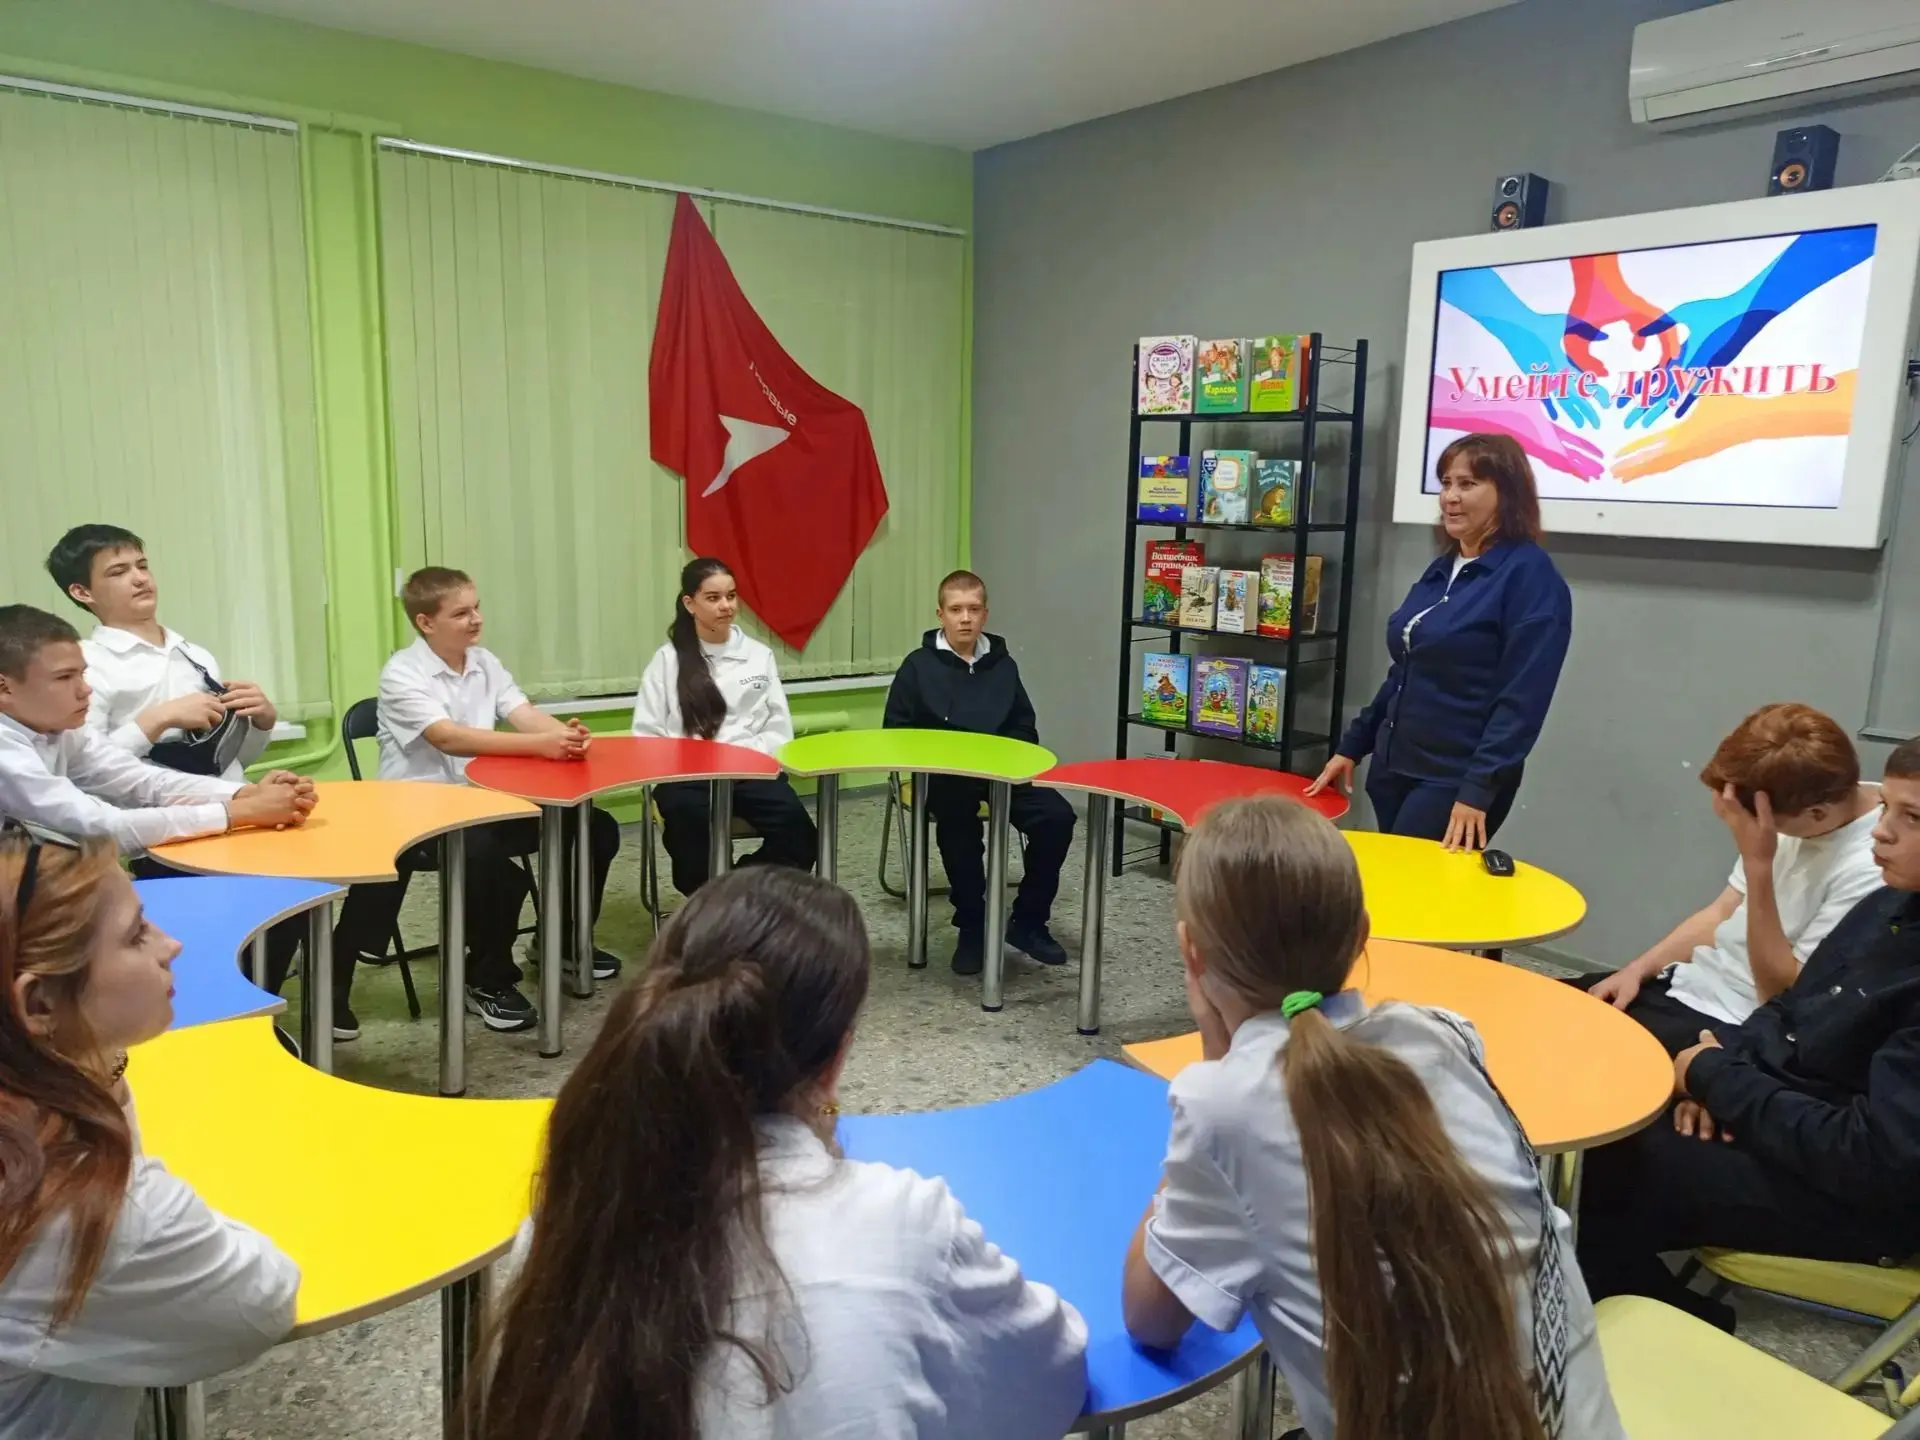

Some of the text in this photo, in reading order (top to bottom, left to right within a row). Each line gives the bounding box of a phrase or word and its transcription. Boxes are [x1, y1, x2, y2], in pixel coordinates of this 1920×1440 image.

[1448, 362, 1838, 409] Умейте дружить
[1151, 551, 1198, 562] Волшебник
[1151, 562, 1185, 571] страны
